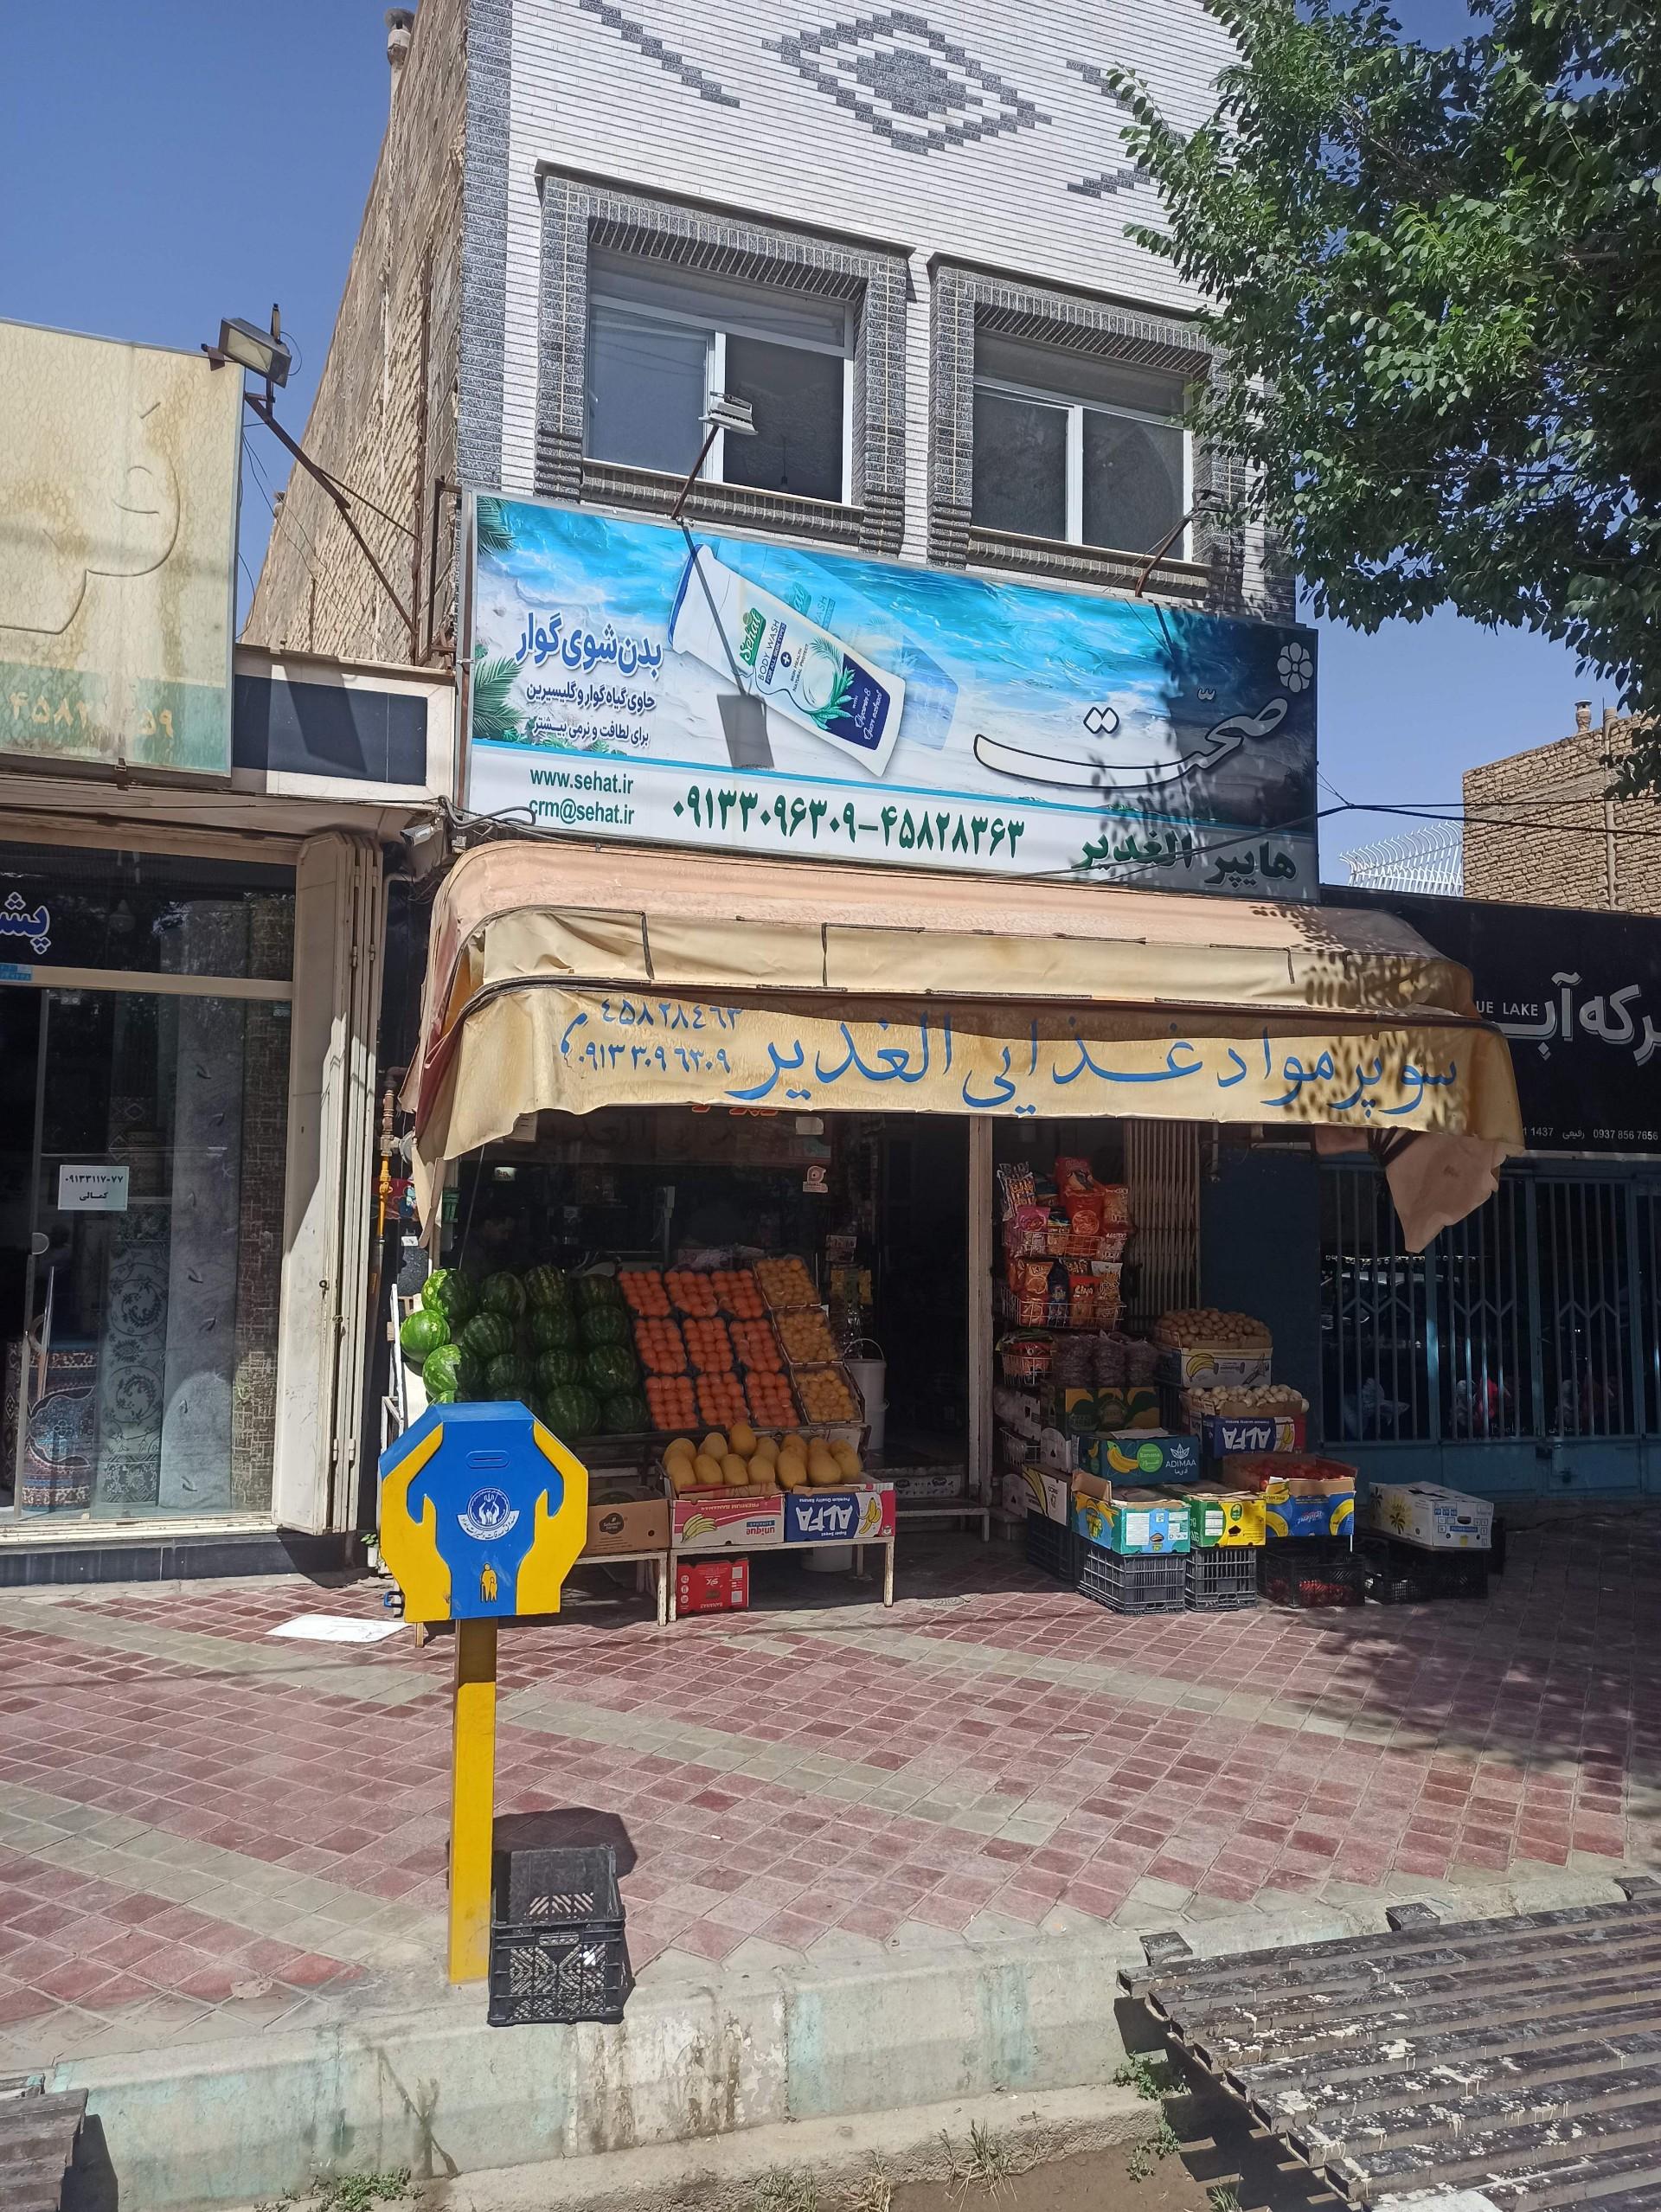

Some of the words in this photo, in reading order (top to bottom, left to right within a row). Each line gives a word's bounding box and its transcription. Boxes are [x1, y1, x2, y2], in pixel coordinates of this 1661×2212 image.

[516, 612, 562, 665] گوار
[740, 610, 762, 662] Sehat
[777, 623, 786, 642] TYPES
[758, 651, 770, 681] BODY
[767, 619, 780, 650] WASH
[527, 681, 578, 703] گلیسیرین
[578, 690, 585, 705] و
[586, 683, 606, 707] گوار
[606, 686, 627, 709] گیاه
[627, 691, 656, 713] حاوی
[568, 722, 590, 741] نرمی
[592, 727, 598, 740] و
[600, 721, 629, 741] لطافت
[631, 729, 649, 747] برای
[530, 768, 634, 795] www.sehat.ir
[529, 798, 635, 825] crm@sehat.ir
[1503, 1001, 1539, 1016] LAKE
[1579, 984, 1661, 1067] رکه
[724, 1010, 952, 1102] الغدیر
[1215, 1026, 1337, 1108] مواد
[1328, 1050, 1457, 1119] سوپر
[1530, 1126, 1555, 1138] 1437
[1593, 1128, 1615, 1139] 0937
[1617, 1129, 1634, 1140] 856
[1637, 1131, 1658, 1141] 7656
[80, 1191, 109, 1202] کمالی
[1222, 1426, 1272, 1451] ALFA
[1165, 1459, 1197, 1468] ADIMAA
[795, 1504, 854, 1532] ALFA
[747, 1526, 775, 1536] unique
